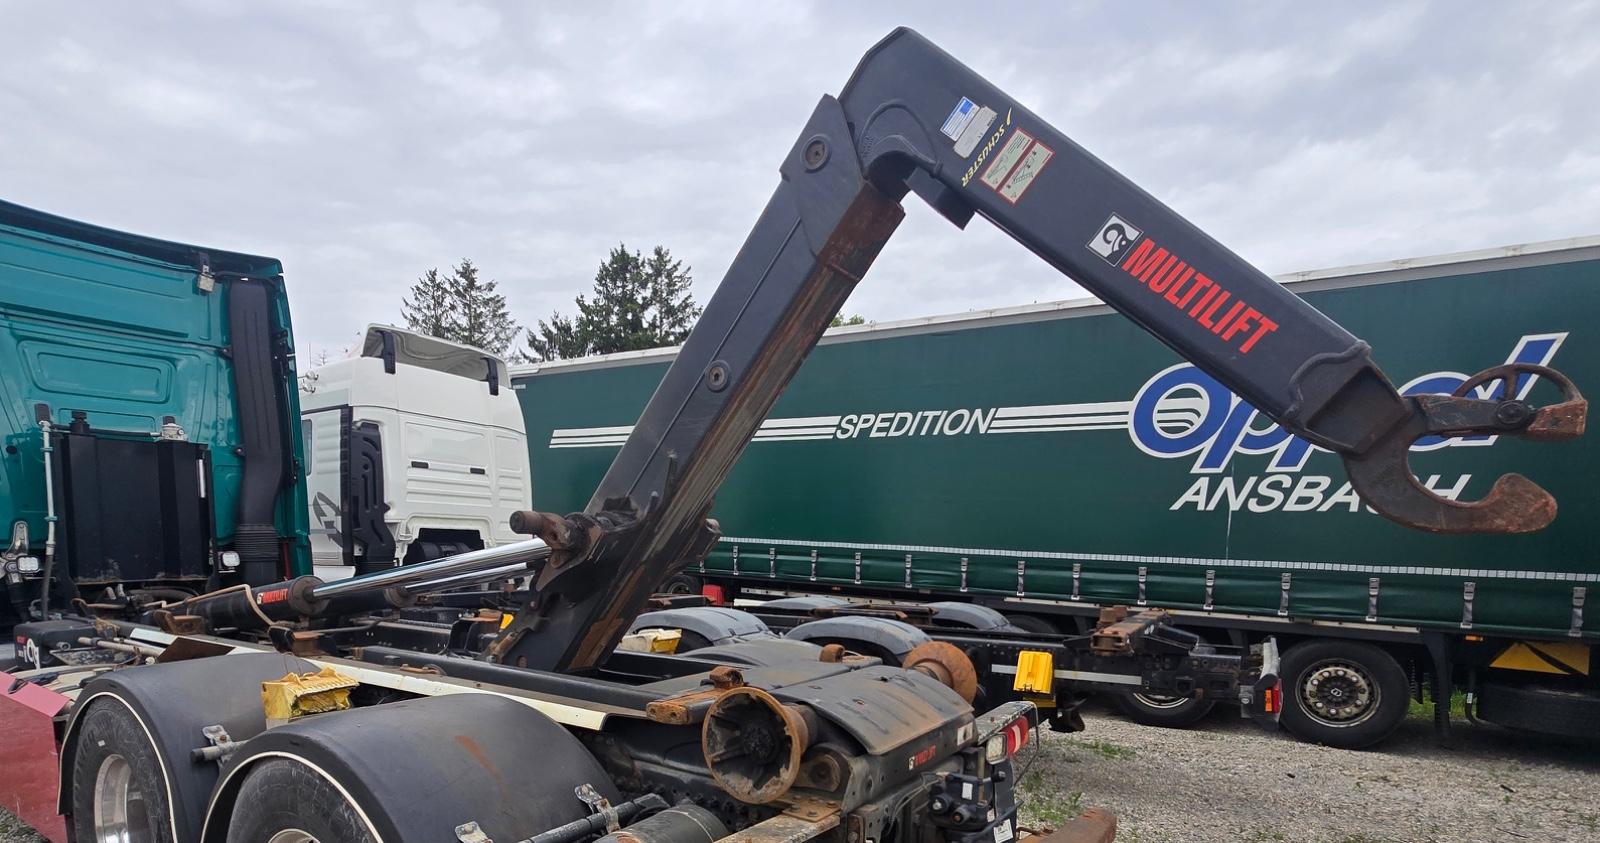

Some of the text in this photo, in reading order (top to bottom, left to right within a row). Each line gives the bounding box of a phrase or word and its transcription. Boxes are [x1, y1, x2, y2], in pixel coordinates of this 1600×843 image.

[961, 125, 1005, 187] SCHUSTER
[1122, 238, 1279, 353] MULTILIFT
[836, 408, 996, 439] SPEDITION
[1169, 474, 1472, 513] ANSBAH
